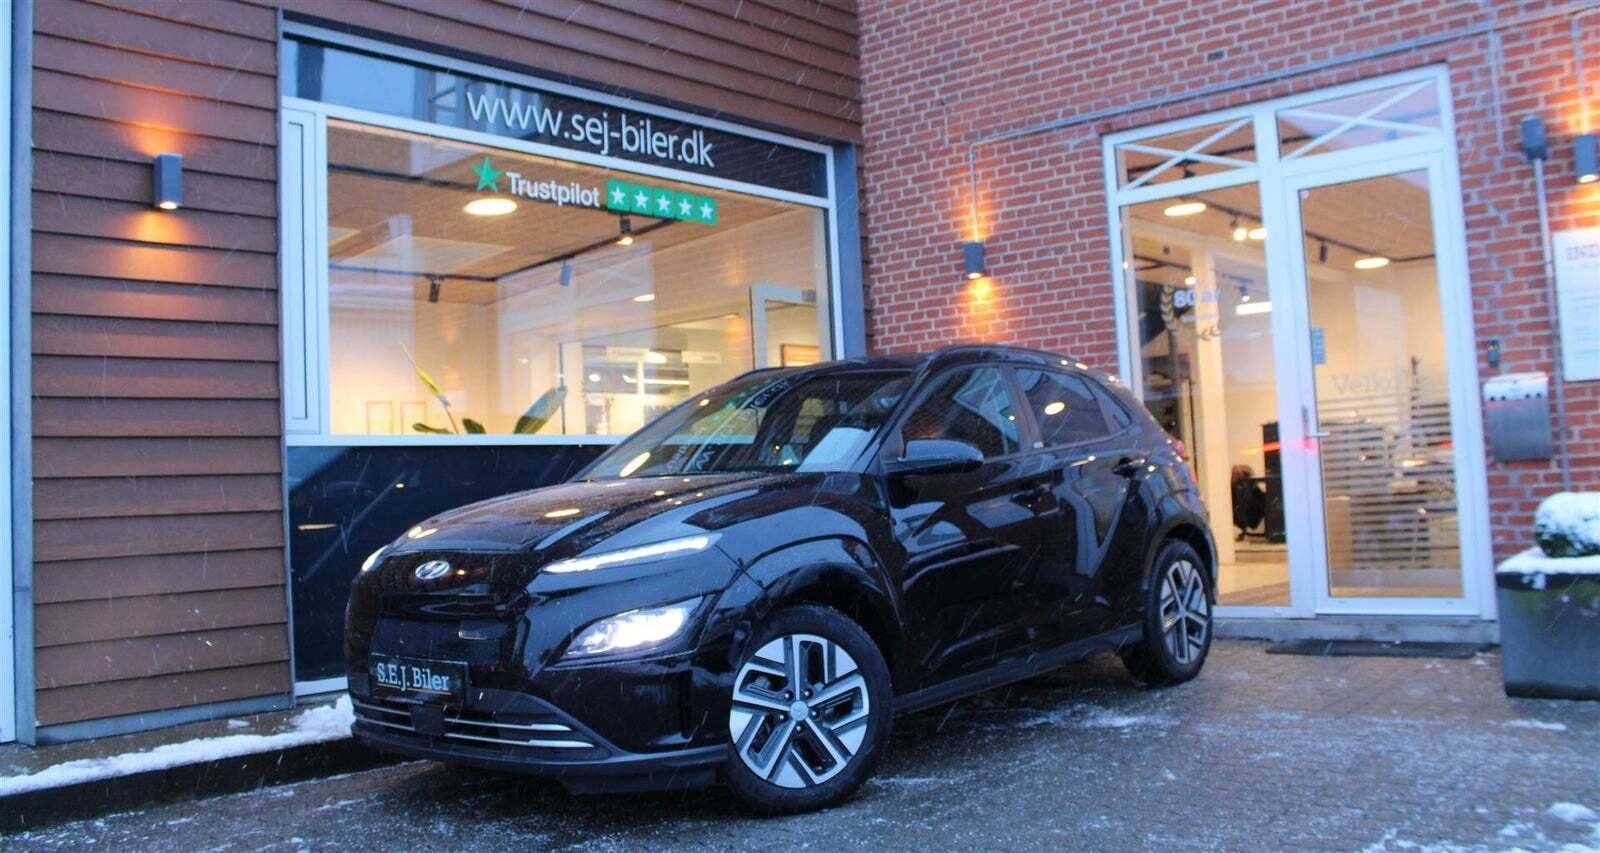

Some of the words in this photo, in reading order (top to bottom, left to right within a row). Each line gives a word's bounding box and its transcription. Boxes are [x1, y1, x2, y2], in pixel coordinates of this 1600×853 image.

[467, 91, 714, 167] www.sej-biler.dk
[506, 172, 600, 207] Trustpilot
[1173, 288, 1196, 308] 80
[377, 662, 410, 691] S.E.J.
[412, 668, 449, 690] Biler
